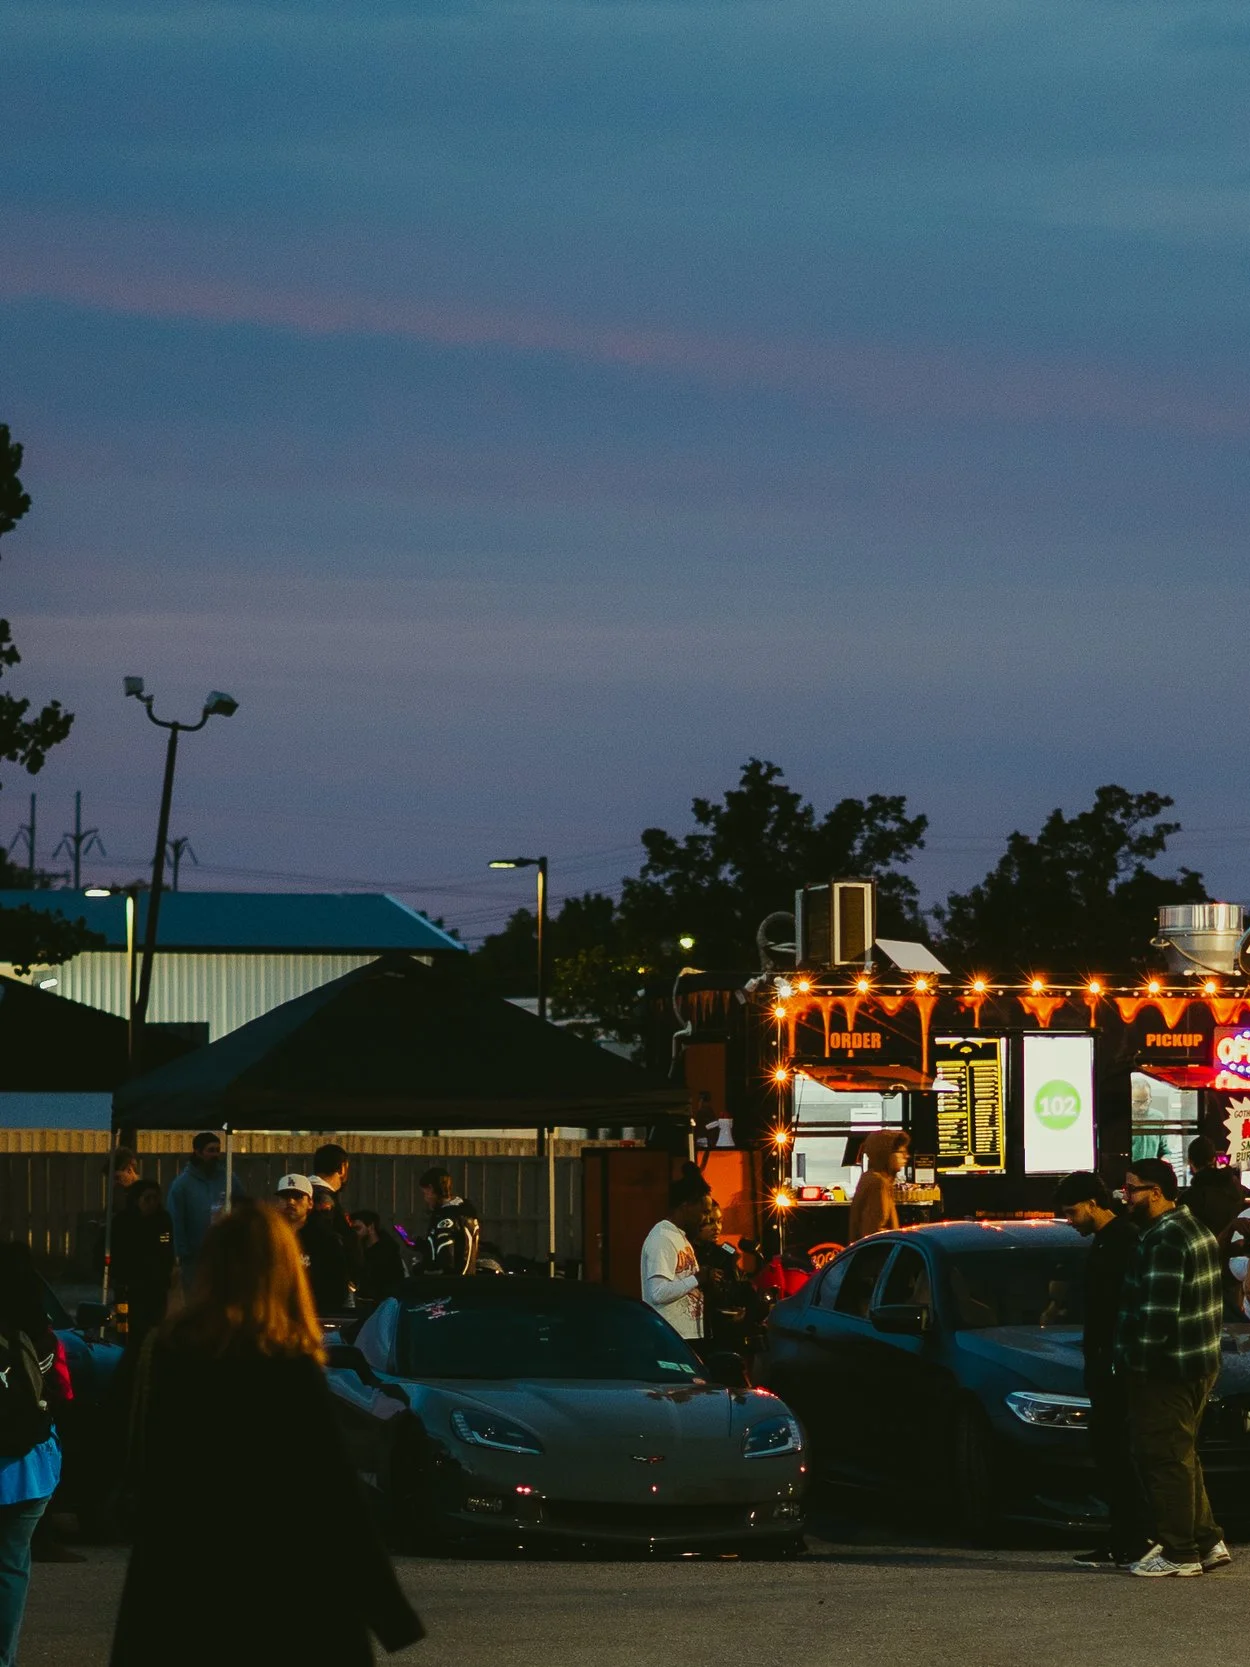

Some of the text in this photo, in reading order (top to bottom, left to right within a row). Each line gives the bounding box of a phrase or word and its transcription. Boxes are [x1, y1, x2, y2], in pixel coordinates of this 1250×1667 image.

[830, 1032, 882, 1049] ORDER
[1146, 1033, 1203, 1047] PICKUP
[1039, 1096, 1077, 1117] 102
